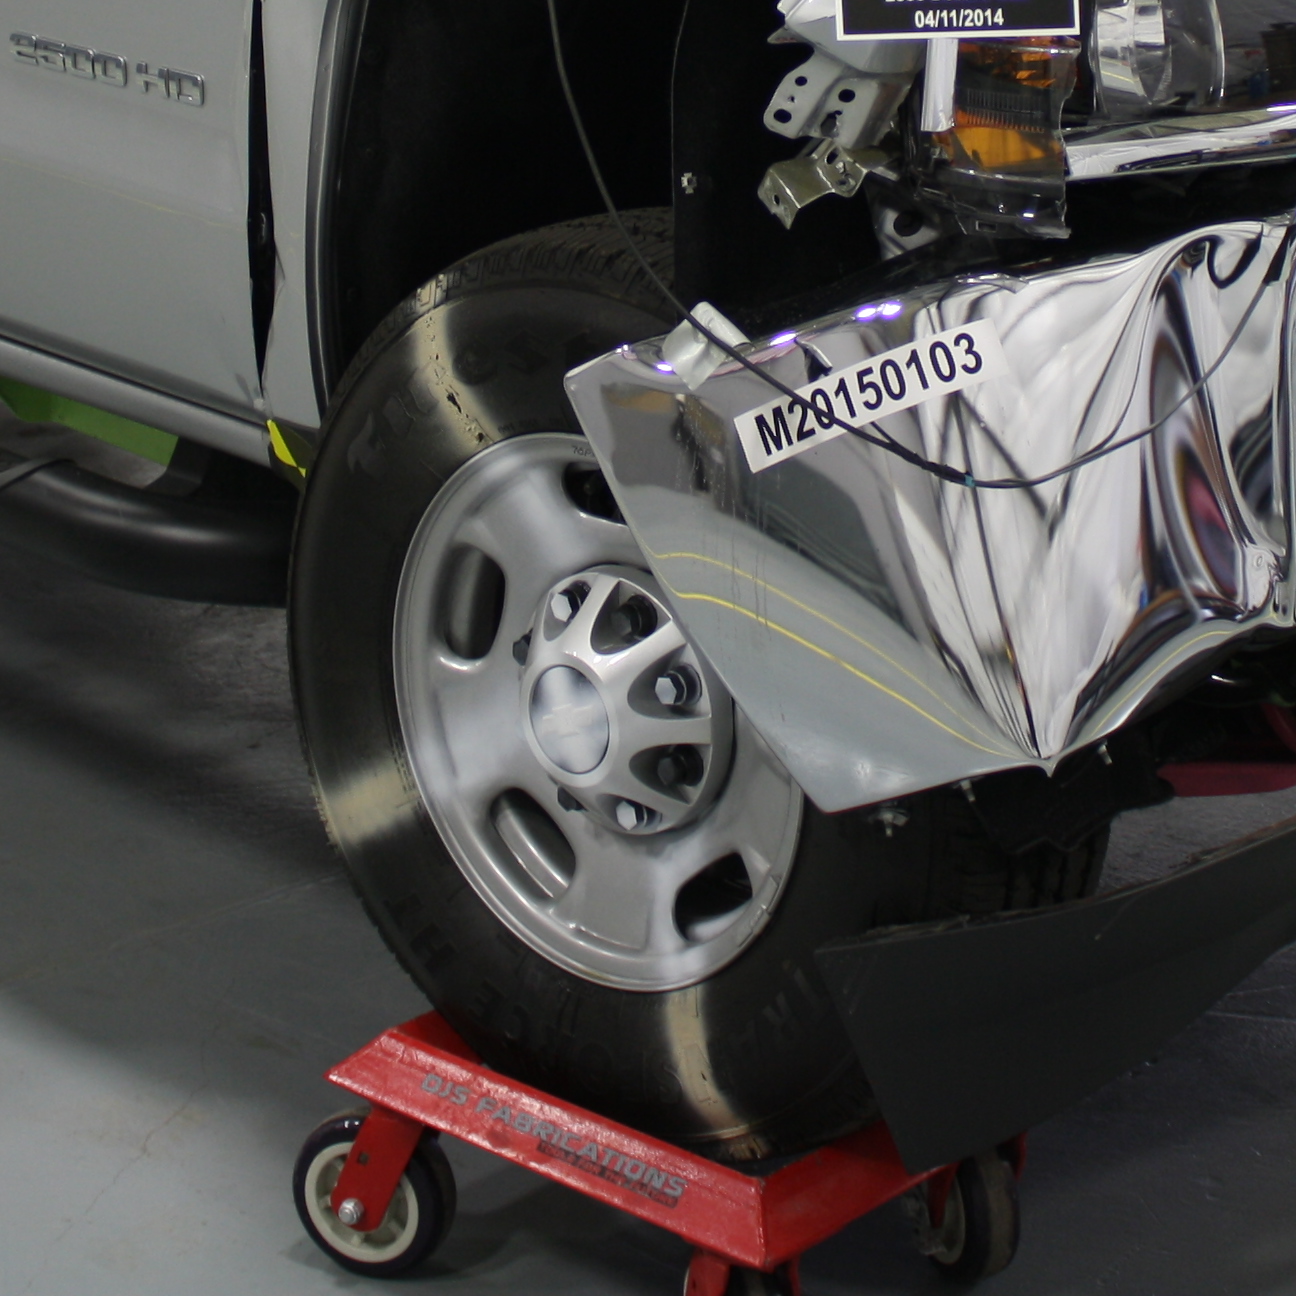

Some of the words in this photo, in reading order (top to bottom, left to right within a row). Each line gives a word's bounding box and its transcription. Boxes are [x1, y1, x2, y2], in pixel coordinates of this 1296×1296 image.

[914, 8, 1004, 29] 04/11/2014
[10, 31, 127, 88] 2500
[136, 61, 205, 107] HD
[754, 332, 983, 457] M20150103
[421, 1073, 472, 1106] DJS
[475, 1096, 689, 1198] FABRICATIONS
